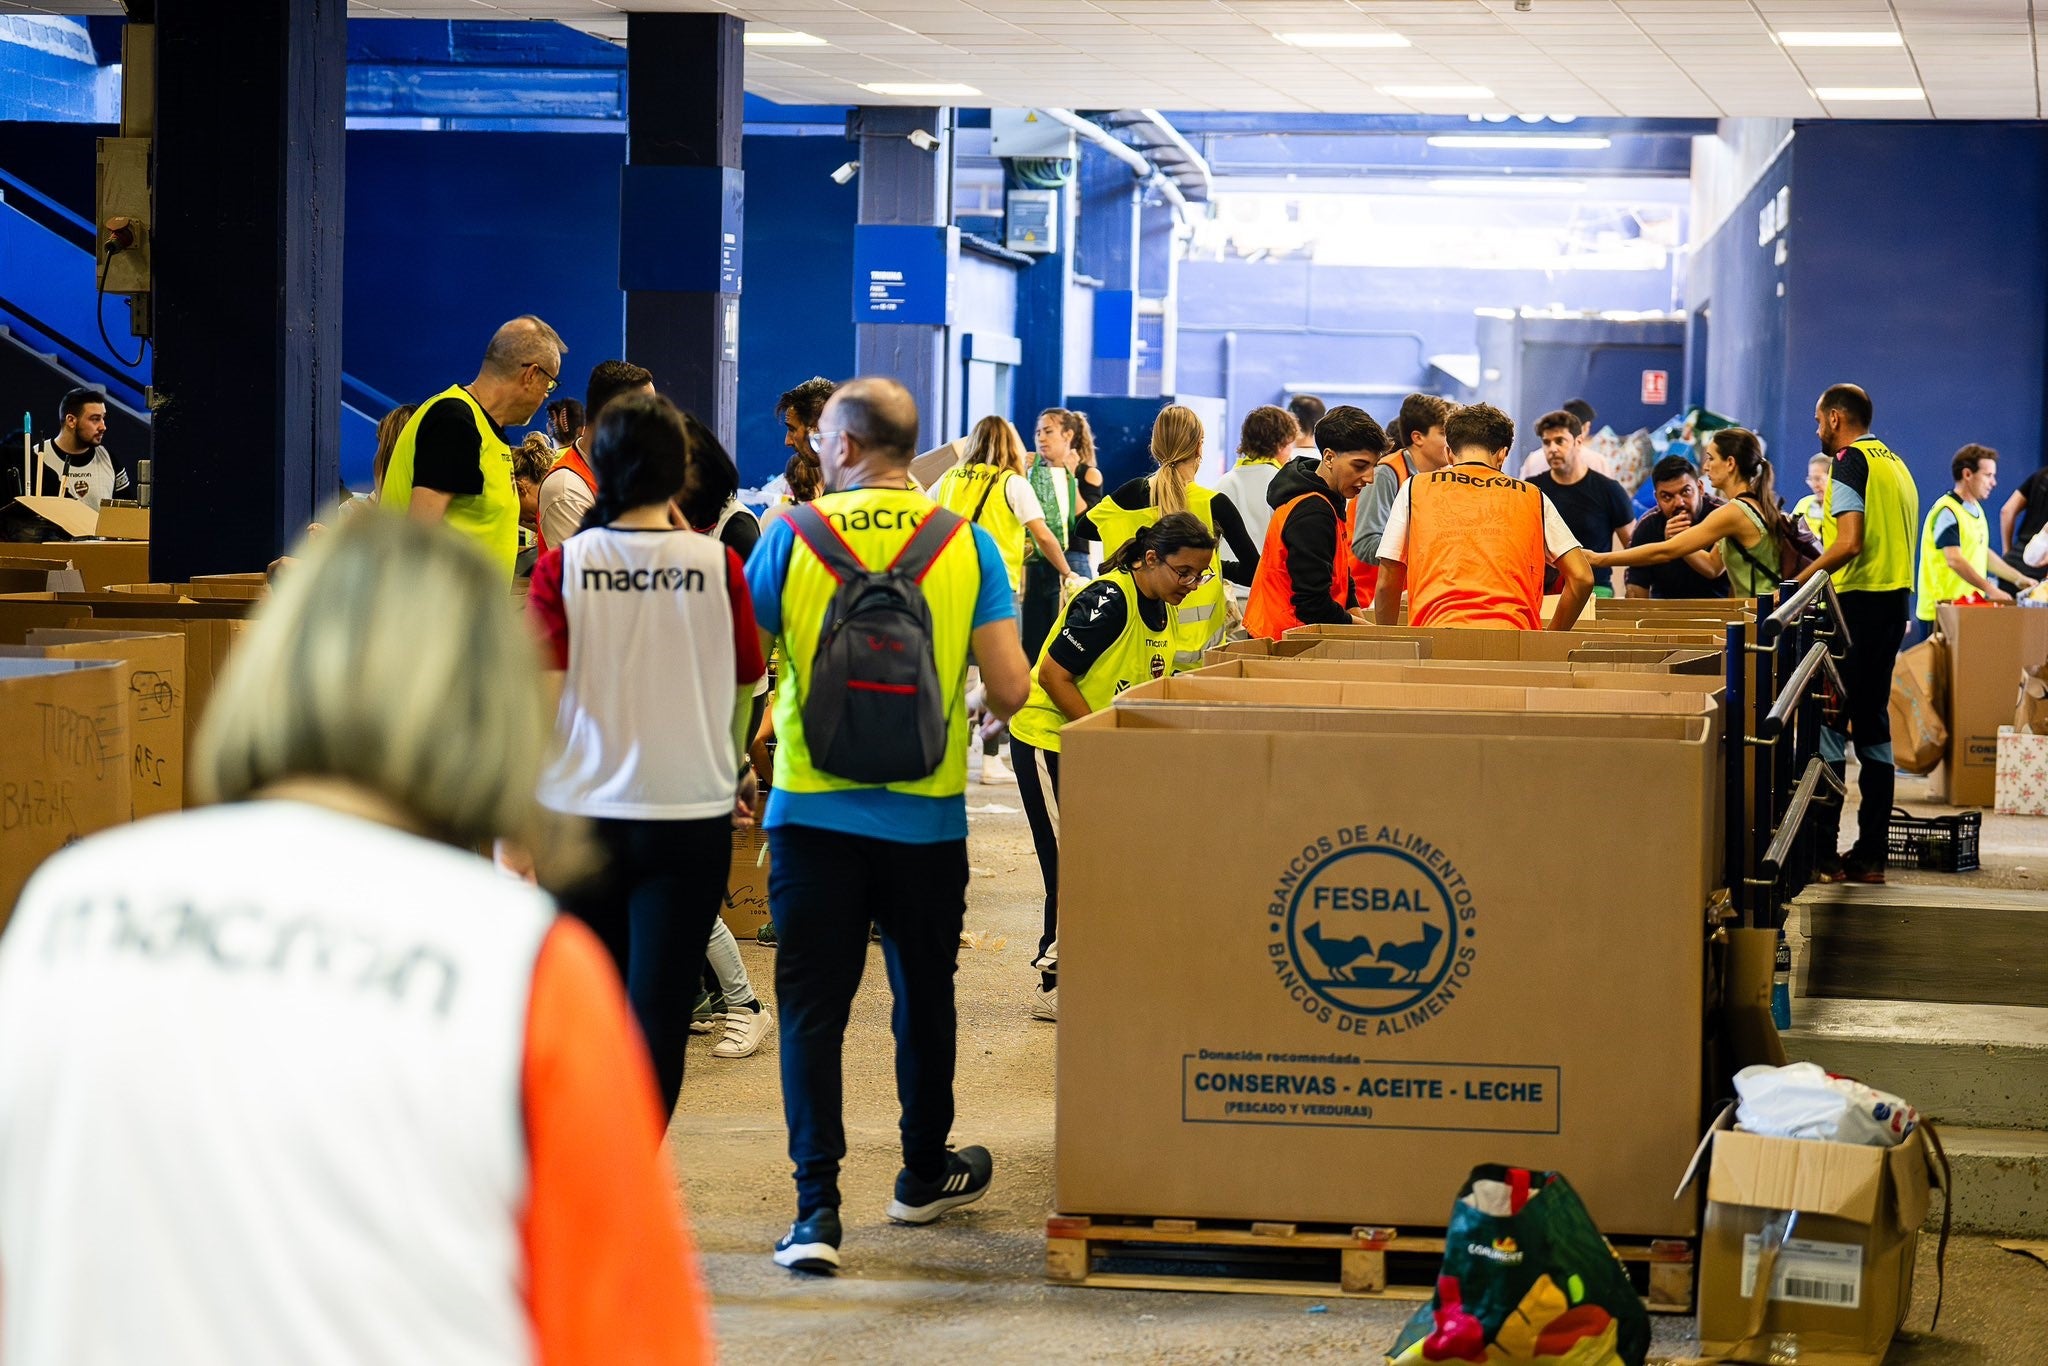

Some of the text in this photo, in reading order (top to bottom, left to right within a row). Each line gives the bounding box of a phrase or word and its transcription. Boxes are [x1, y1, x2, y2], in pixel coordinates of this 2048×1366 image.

[1431, 471, 1526, 493] macron
[581, 568, 705, 592] macron
[1268, 825, 1477, 922] BANCOS DE ALIMENTOS
[1313, 886, 1430, 912] FESBAL
[1268, 942, 1477, 1037] BANCOS DE ALIMENTOS
[1199, 1049, 1361, 1065] Donación recomendada
[1195, 1072, 1337, 1096] CONSERVAS
[1357, 1077, 1443, 1099] ACEITE
[1465, 1081, 1543, 1103] LECHE
[1289, 1104, 1298, 1114] Y
